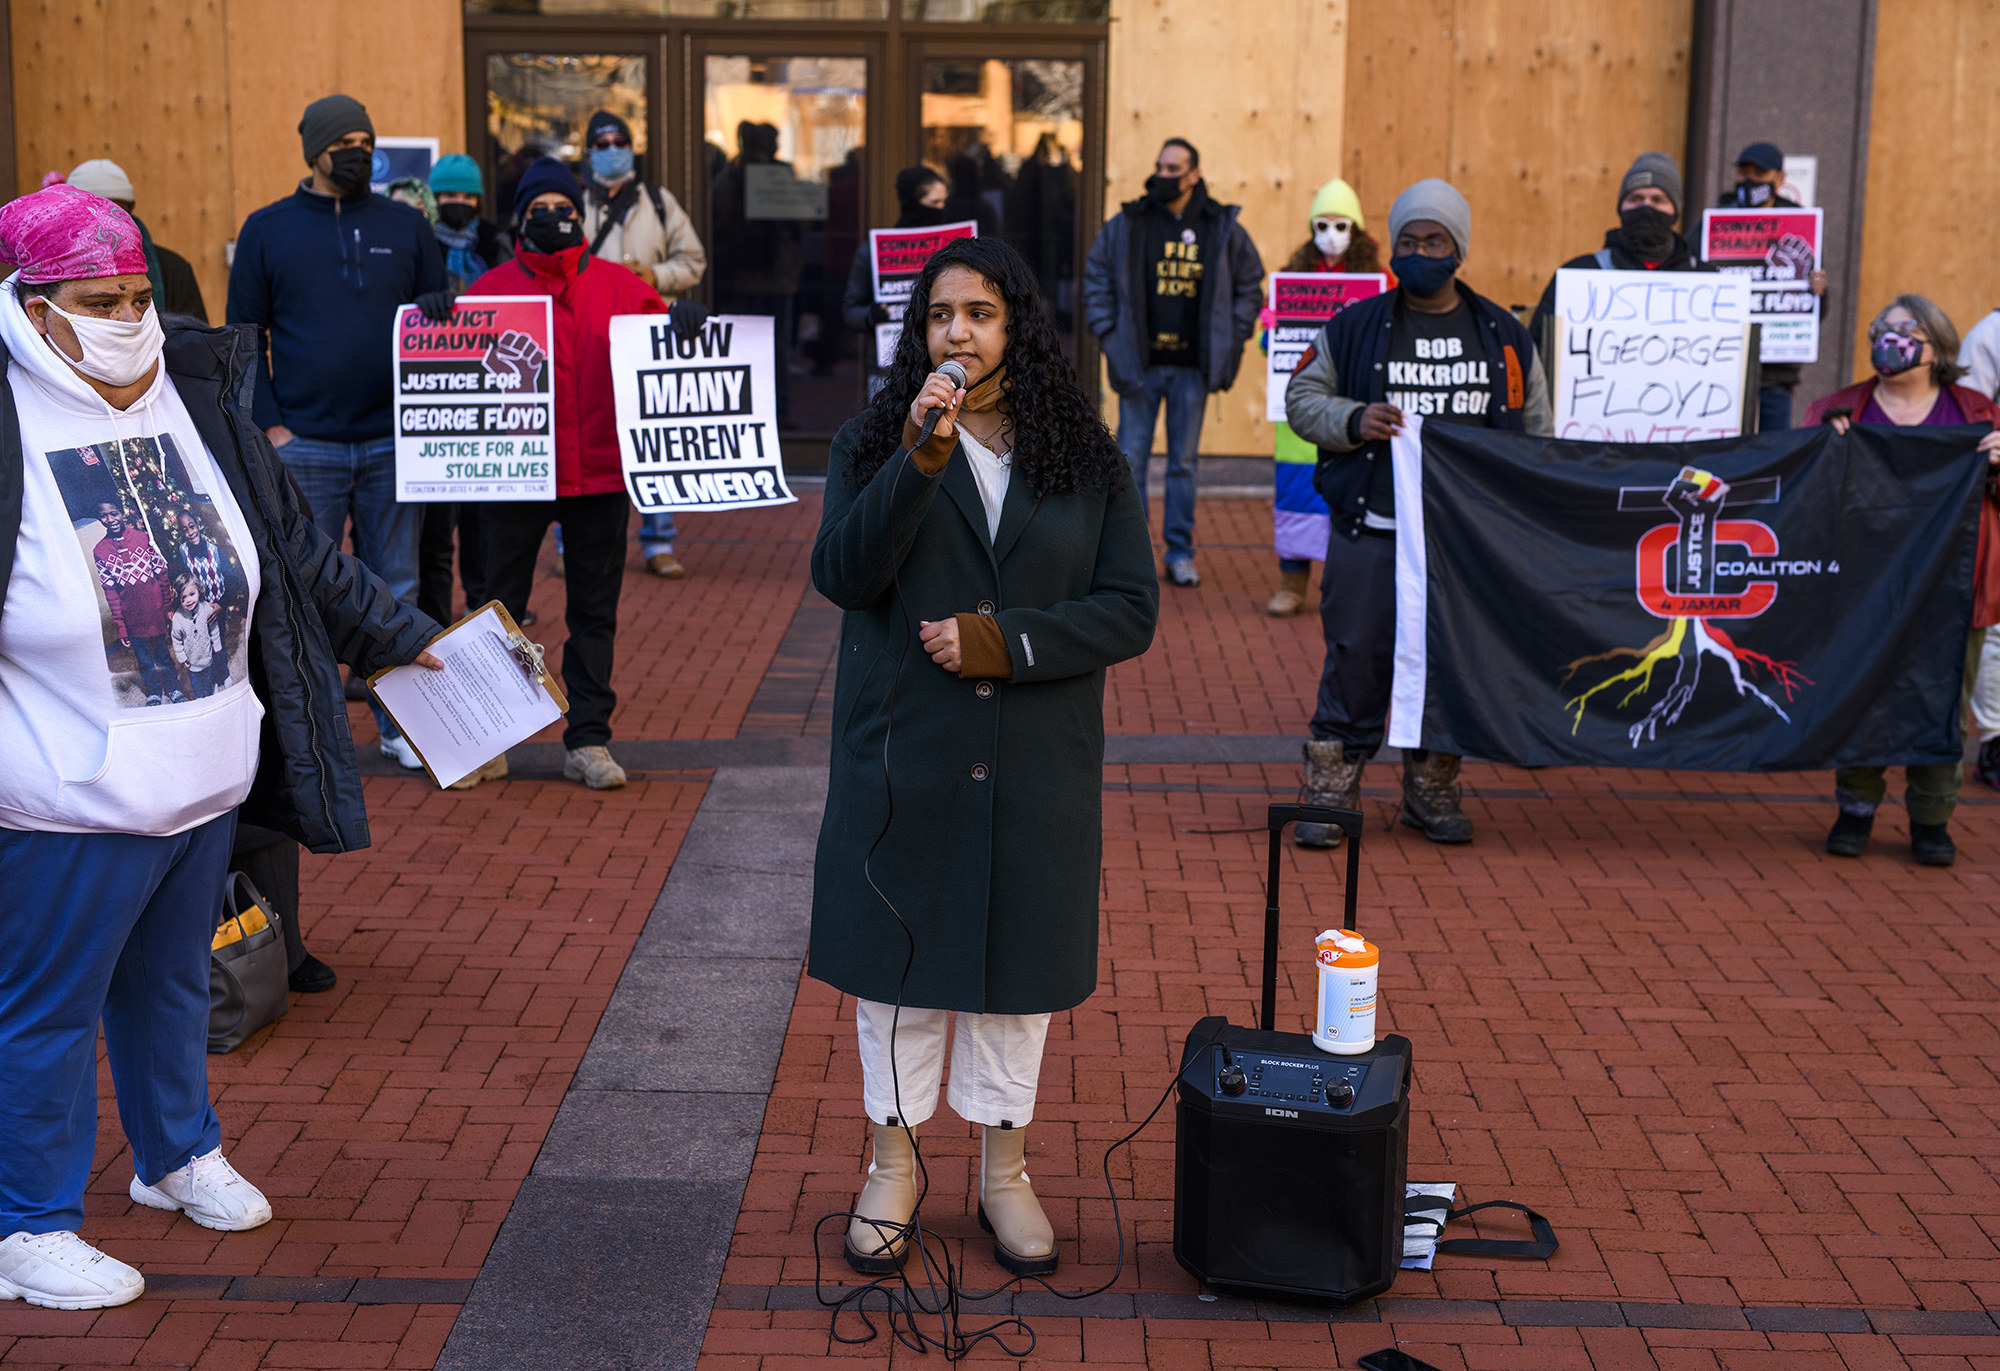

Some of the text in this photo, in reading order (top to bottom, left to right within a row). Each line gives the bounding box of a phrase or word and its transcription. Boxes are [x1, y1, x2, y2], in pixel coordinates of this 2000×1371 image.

[1712, 220, 1779, 233] CONVICT
[880, 237, 939, 252] CONVICT
[1766, 266, 1796, 281] FOR
[1279, 283, 1344, 297] CONVICT
[1567, 280, 1740, 326] JUSTICE
[1765, 292, 1814, 312] FLOYD
[403, 333, 499, 350] CHAUVIN
[650, 323, 733, 361] HOW
[1415, 337, 1463, 359] BOB
[402, 373, 521, 391] JUSTICE FOR
[1387, 361, 1490, 386] KKKROLL
[643, 370, 745, 415] MANY
[1570, 377, 1732, 419] FLOYD
[1452, 390, 1491, 415] GO!
[401, 406, 548, 432] GEORGE FLOYD
[419, 441, 548, 457] JUSTICE FOR ALL
[630, 423, 766, 463] WEREN'T
[446, 462, 549, 478] STOLEN LIVES
[636, 470, 777, 505] FILMED?
[1687, 513, 1705, 589] JUSTICE
[1715, 560, 1840, 577] COALITION 4
[1660, 599, 1741, 611] 4 JAMAR
[1261, 1059, 1280, 1067] BLOCK
[1281, 1061, 1304, 1069] ROCKER
[1265, 1107, 1298, 1118] ION
